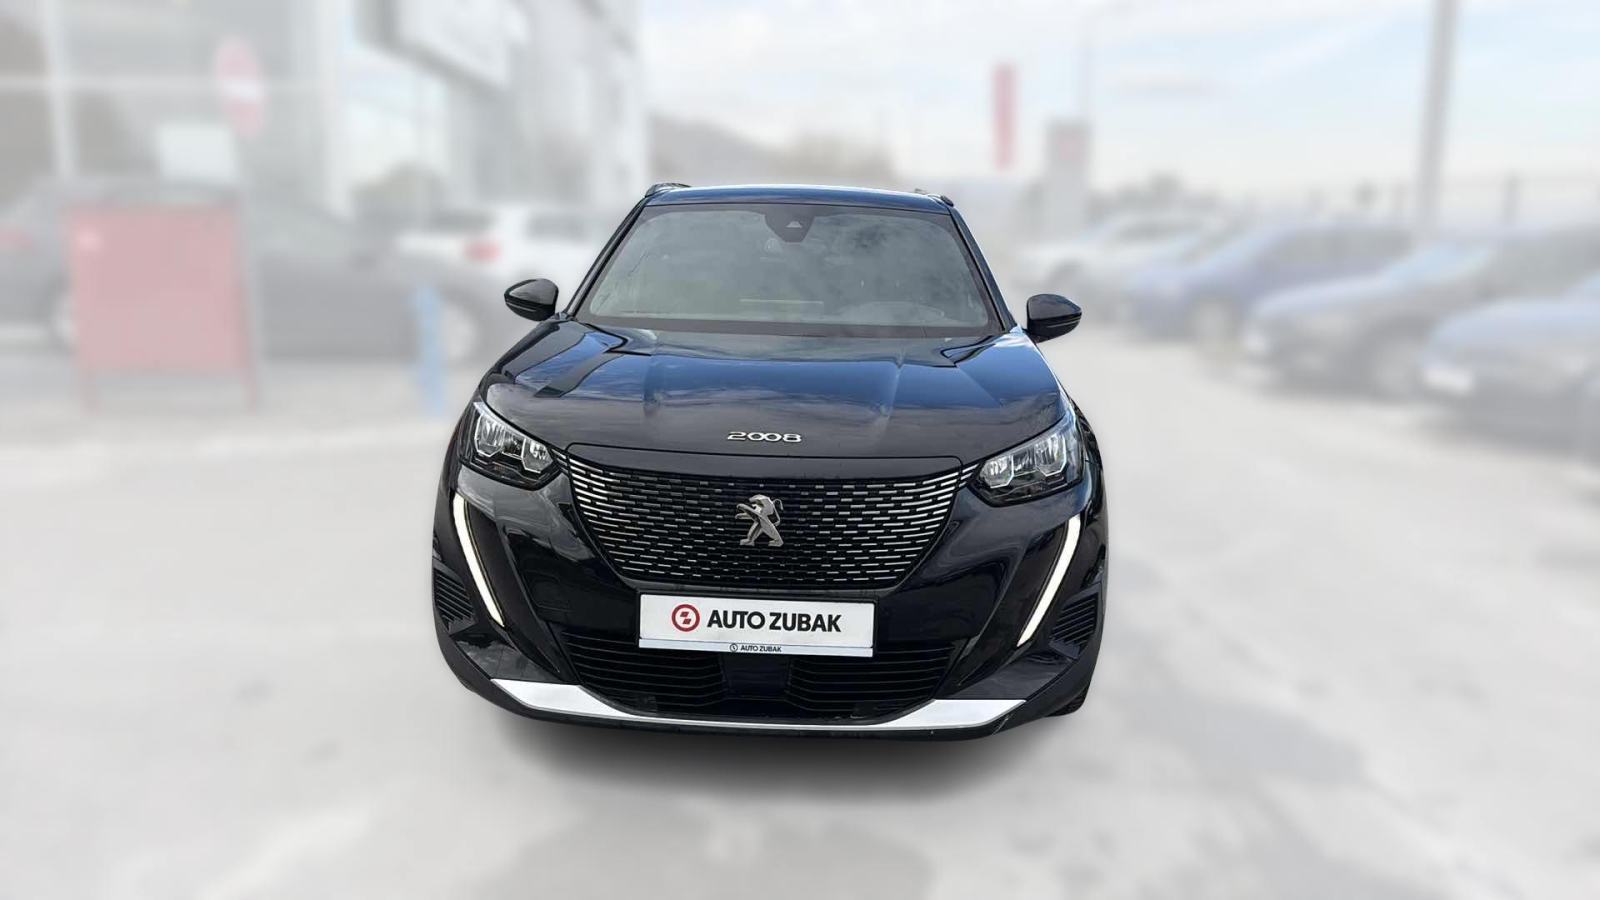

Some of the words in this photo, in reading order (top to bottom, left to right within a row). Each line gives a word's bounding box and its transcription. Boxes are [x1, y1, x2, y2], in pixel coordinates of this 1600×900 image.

[727, 431, 802, 443] 2008
[707, 609, 766, 629] AUTO
[769, 612, 842, 633] ZUBAK
